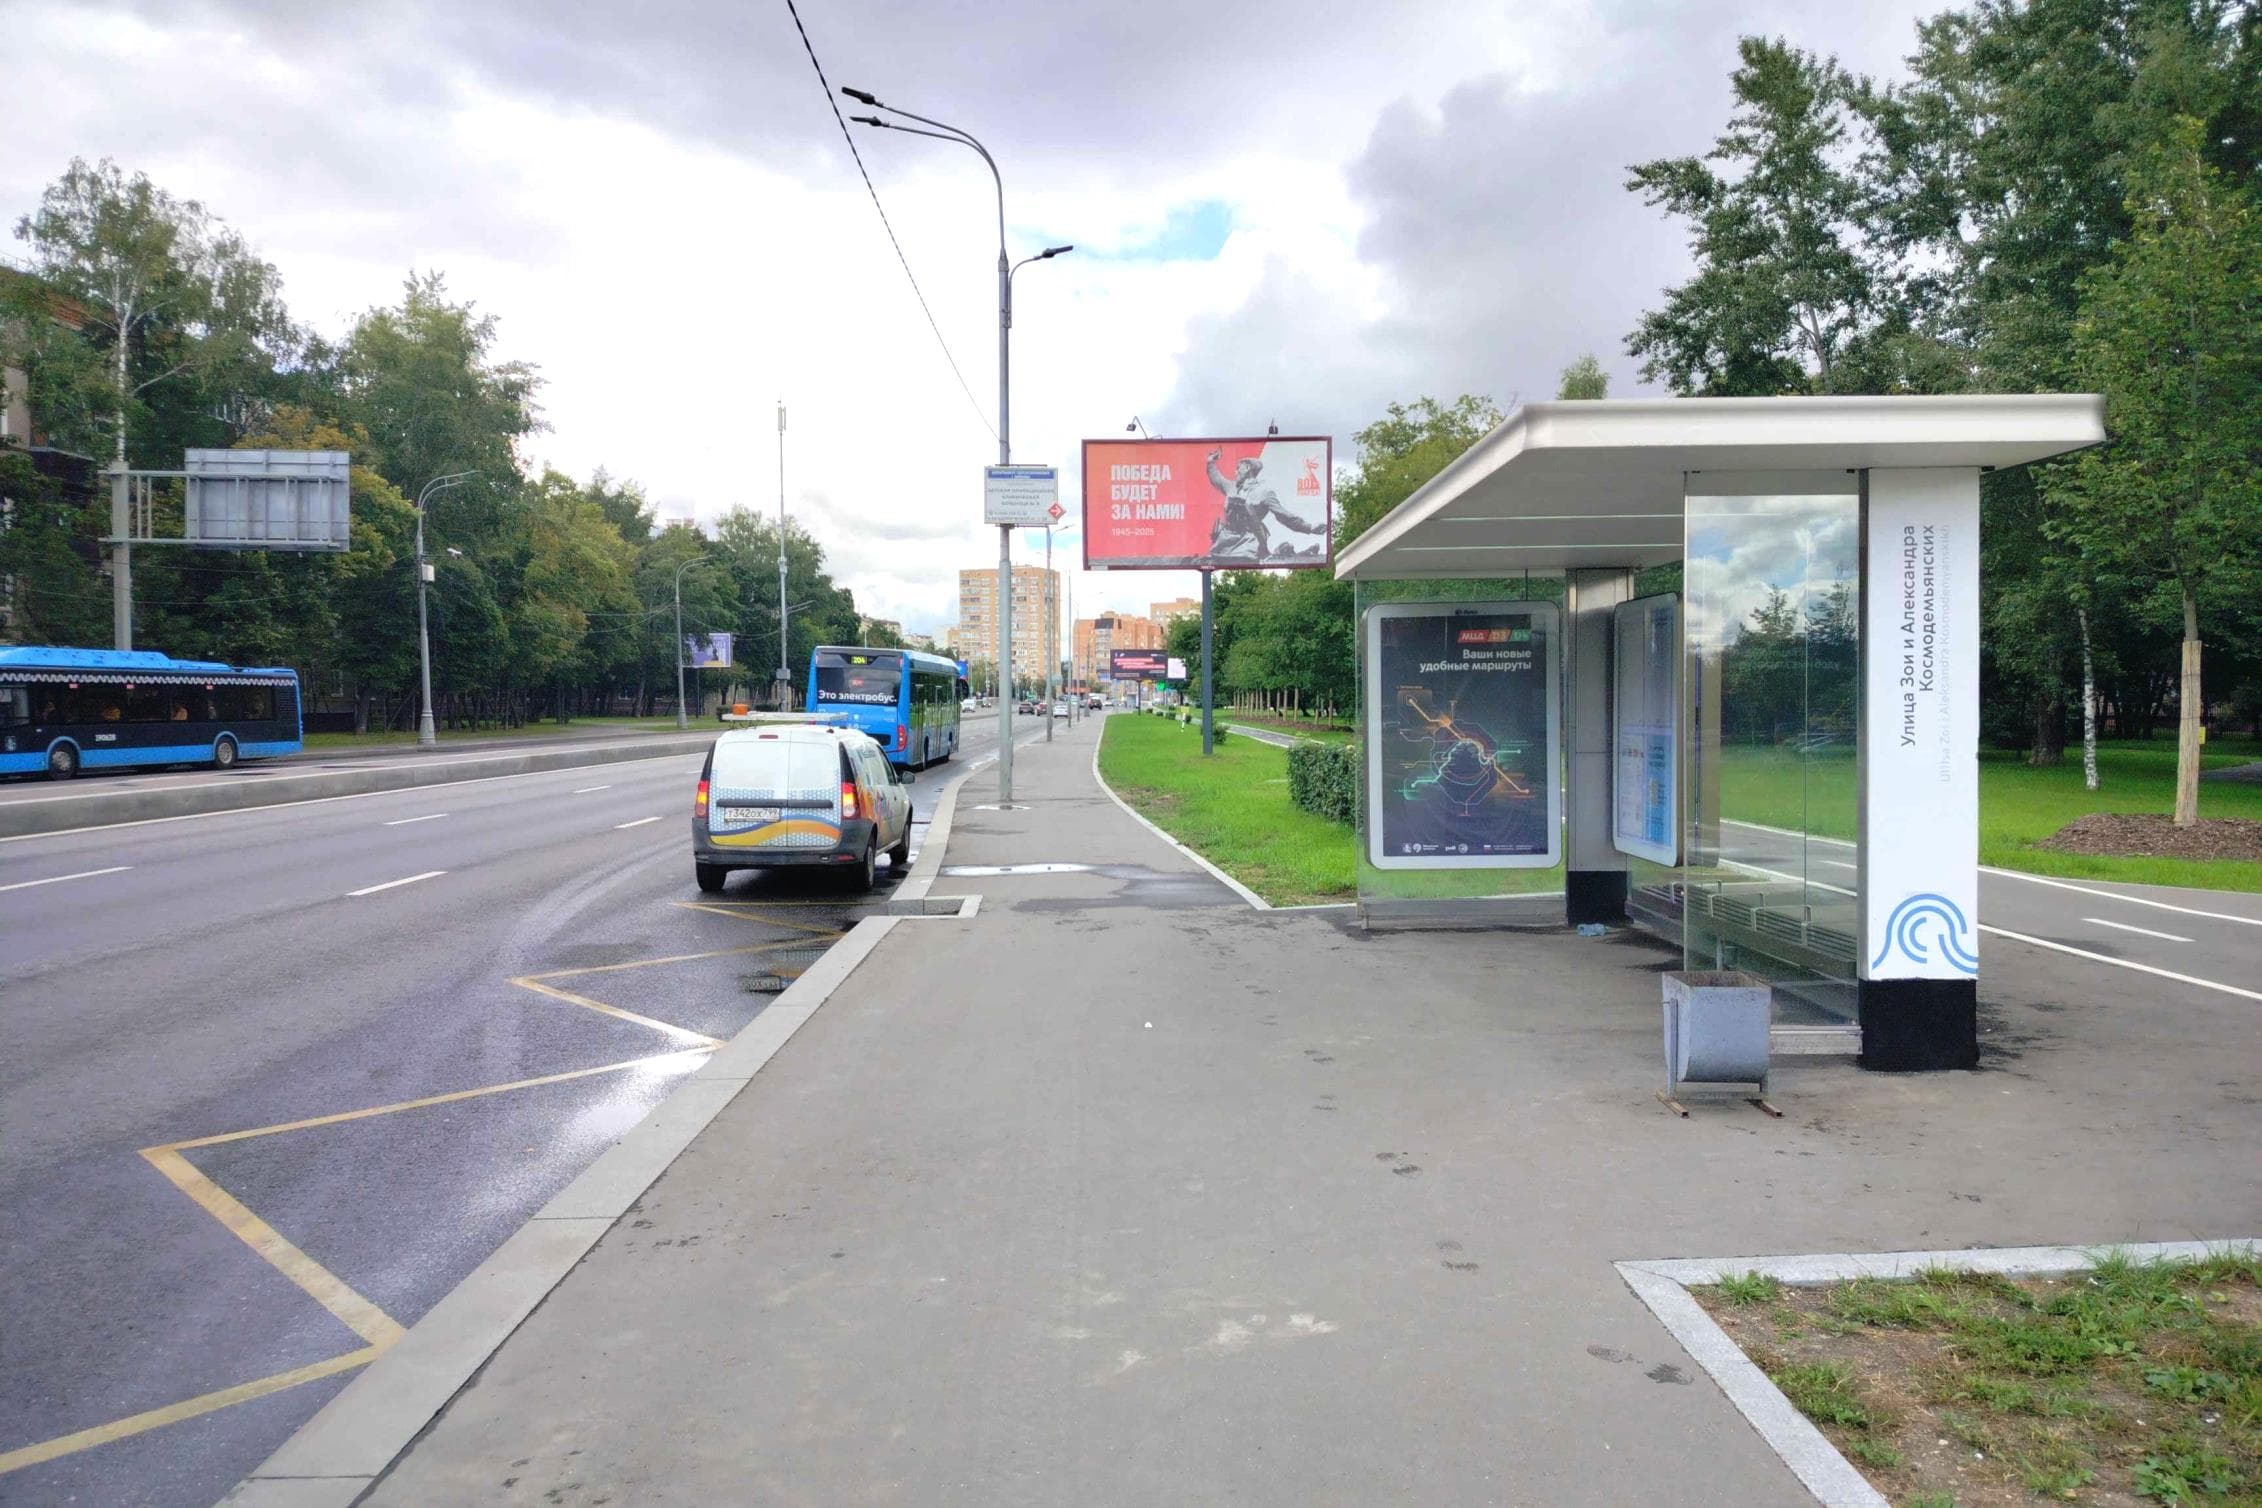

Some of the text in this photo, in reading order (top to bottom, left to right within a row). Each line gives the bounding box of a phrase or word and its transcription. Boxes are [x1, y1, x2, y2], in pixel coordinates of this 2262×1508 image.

[1111, 464, 1171, 483] ПОБЕДА
[1111, 483, 1158, 502] БУДЕТ
[1111, 503, 1185, 520] ЗА НАМИ!
[1921, 524, 1937, 692] Космодемьянских
[1900, 525, 1918, 747] Улица Зои и Александра
[1462, 649, 1532, 659] Ваши новые
[1420, 661, 1532, 673] удобные маршруты
[818, 690, 897, 704] Это электробус.
